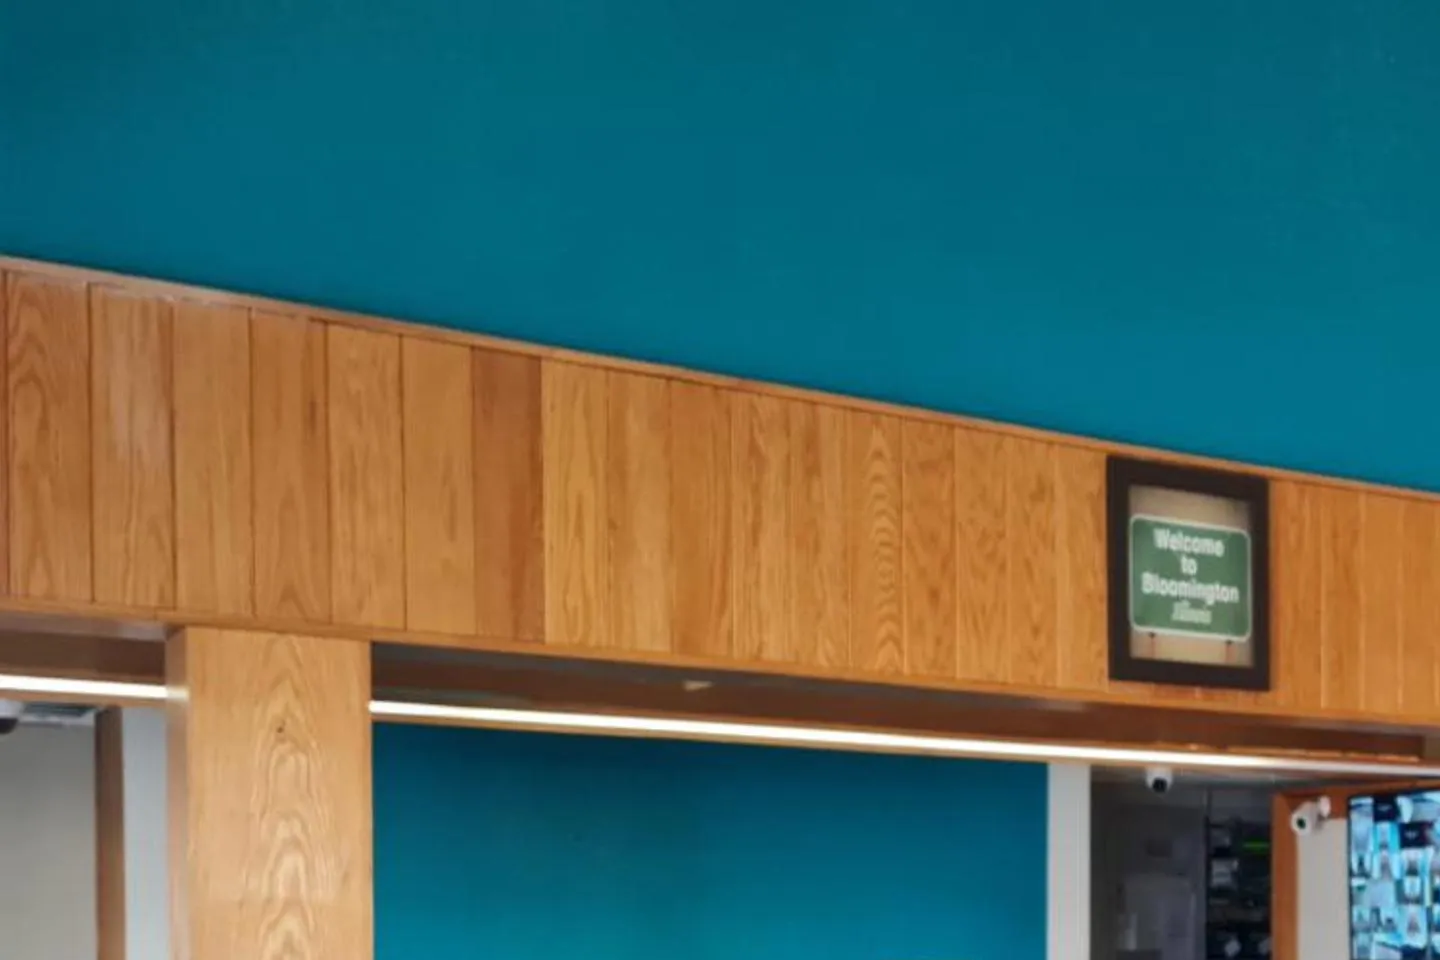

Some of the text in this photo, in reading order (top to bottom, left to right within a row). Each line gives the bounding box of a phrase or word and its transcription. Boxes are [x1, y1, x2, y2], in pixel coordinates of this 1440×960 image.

[1153, 528, 1225, 558] Welcome
[1181, 554, 1198, 576] to
[1141, 571, 1240, 606] Bloomington
